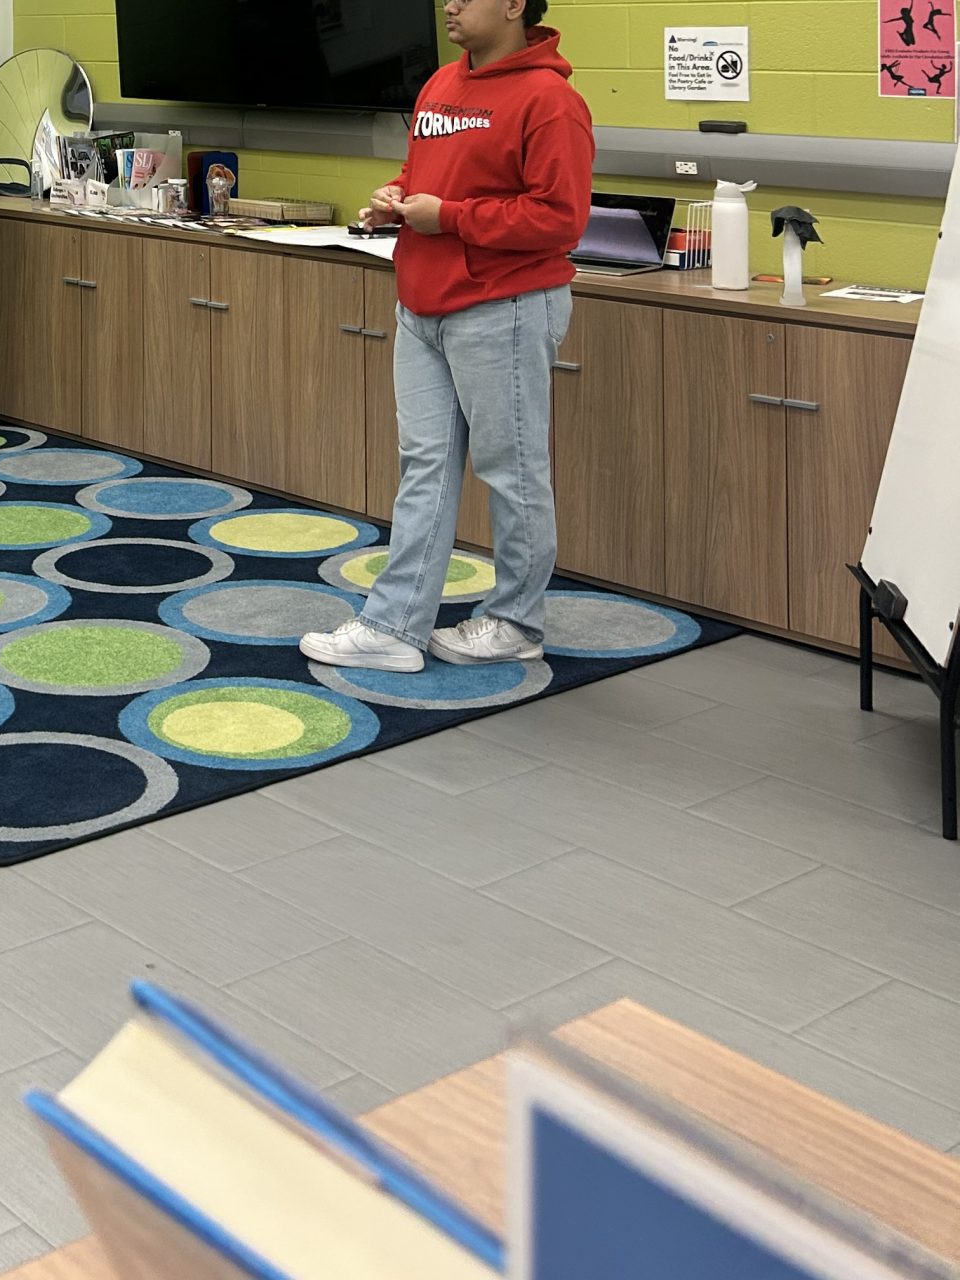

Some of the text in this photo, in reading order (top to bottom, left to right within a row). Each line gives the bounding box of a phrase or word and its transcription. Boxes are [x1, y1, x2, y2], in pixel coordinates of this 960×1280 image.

[668, 54, 713, 62] Food/Drinks
[692, 63, 713, 71] Area.
[413, 111, 490, 139] TORNADOES
[135, 151, 153, 169] SLJ
